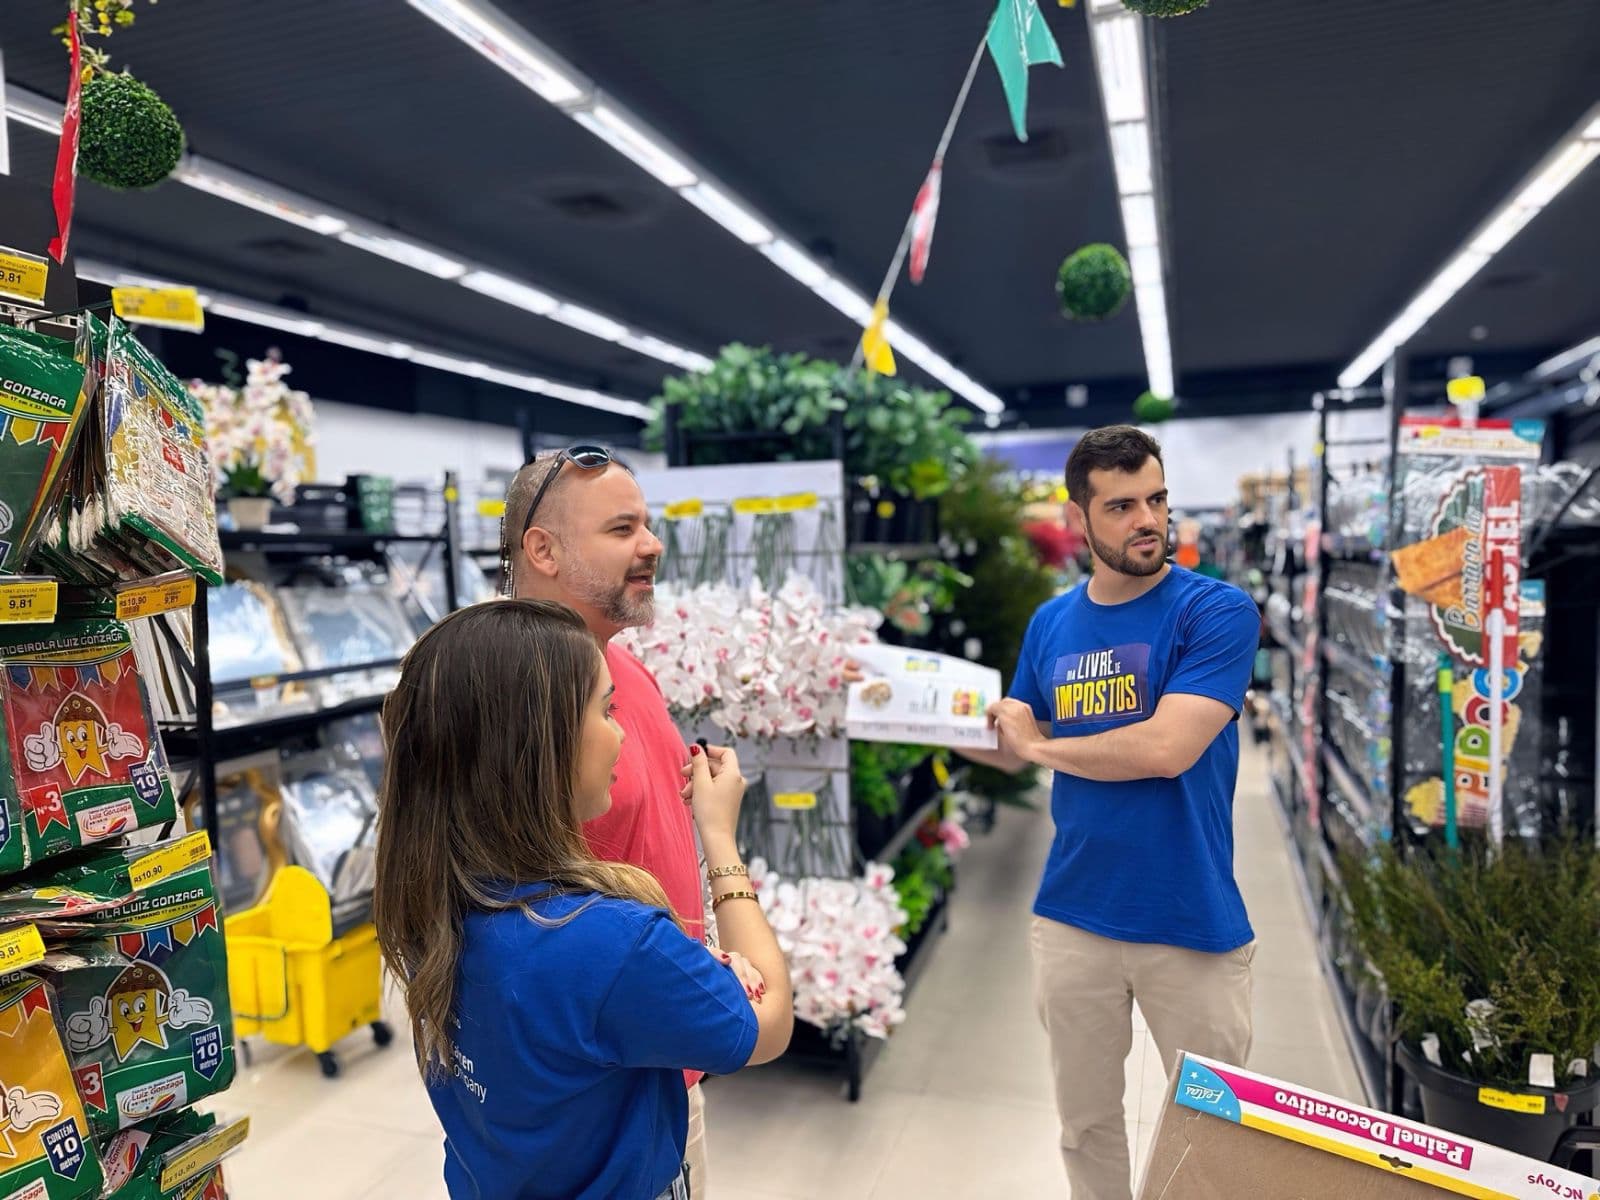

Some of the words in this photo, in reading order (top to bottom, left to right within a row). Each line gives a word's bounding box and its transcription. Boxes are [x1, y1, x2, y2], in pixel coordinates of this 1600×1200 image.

[3, 379, 67, 409] GONZAGA
[9, 599, 32, 610] 9,81
[0, 641, 56, 656] NDEIROLA
[57, 637, 79, 648] LUIZ
[82, 632, 123, 645] GONZAGA
[1077, 649, 1114, 680] LIVRE
[1114, 661, 1121, 674] DE
[1055, 674, 1137, 720] IMPOSTOS
[136, 774, 157, 789] 10
[122, 900, 150, 915] LUIZ
[151, 888, 204, 908] GONZAGA
[196, 1042, 218, 1060] 10
[83, 1071, 101, 1095] 3
[131, 1091, 148, 1101] Luiz
[150, 1078, 184, 1095] Gonzaga
[1185, 1086, 1225, 1104] Festas
[1274, 1090, 1389, 1142] Decorativo
[46, 1124, 75, 1146] CONTÉM
[1393, 1127, 1465, 1165] Painel
[52, 1136, 78, 1159] 10
[59, 1153, 81, 1172] metros
[1527, 1174, 1562, 1196] Toys
[1562, 1186, 1583, 1200] NC
